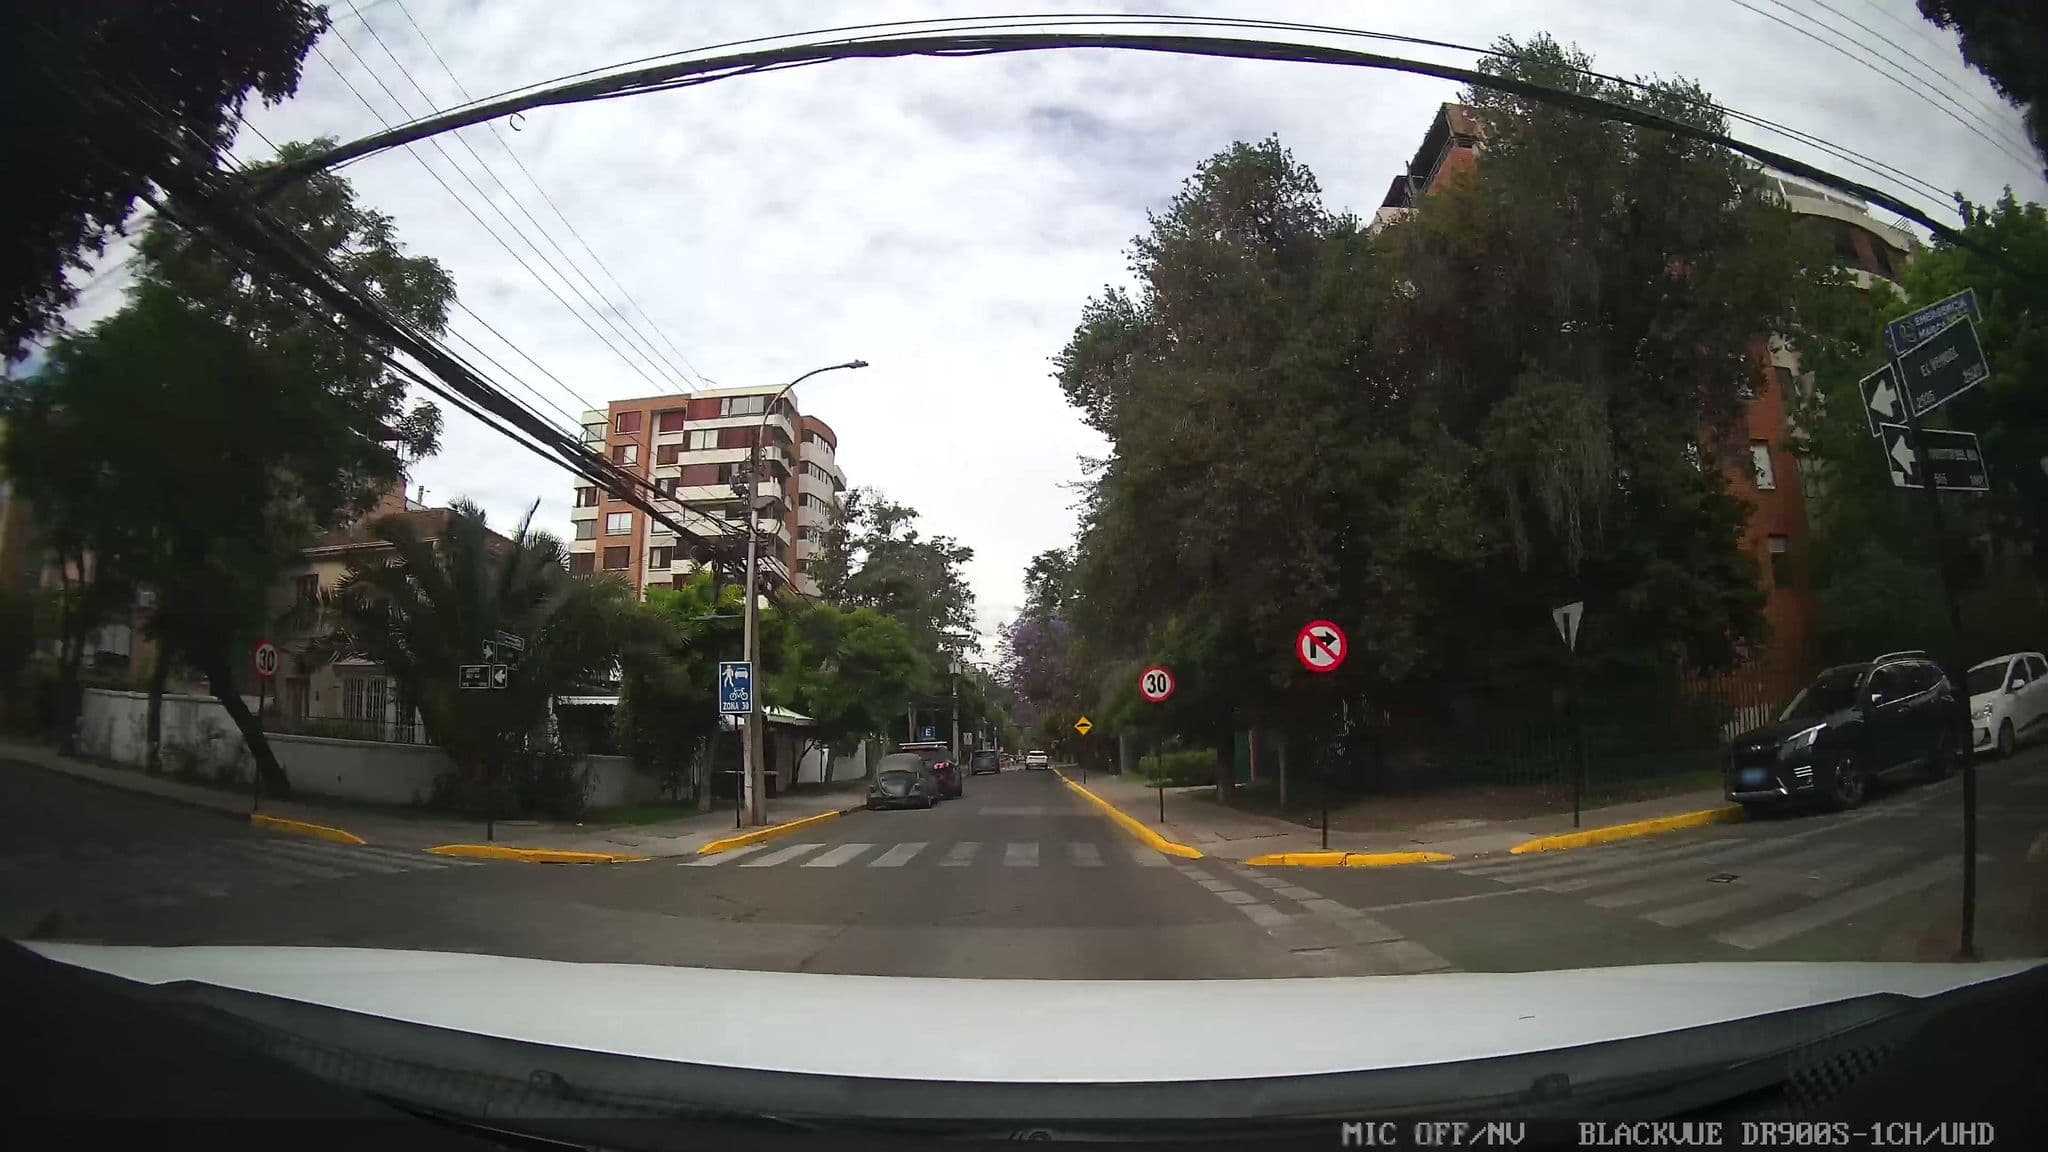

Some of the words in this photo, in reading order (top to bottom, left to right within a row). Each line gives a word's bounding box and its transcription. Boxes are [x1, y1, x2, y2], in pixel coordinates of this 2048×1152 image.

[259, 648, 275, 671] 30
[1147, 673, 1167, 693] 30
[722, 702, 739, 710] ZONA
[741, 702, 749, 710] 30
[925, 728, 931, 736] E
